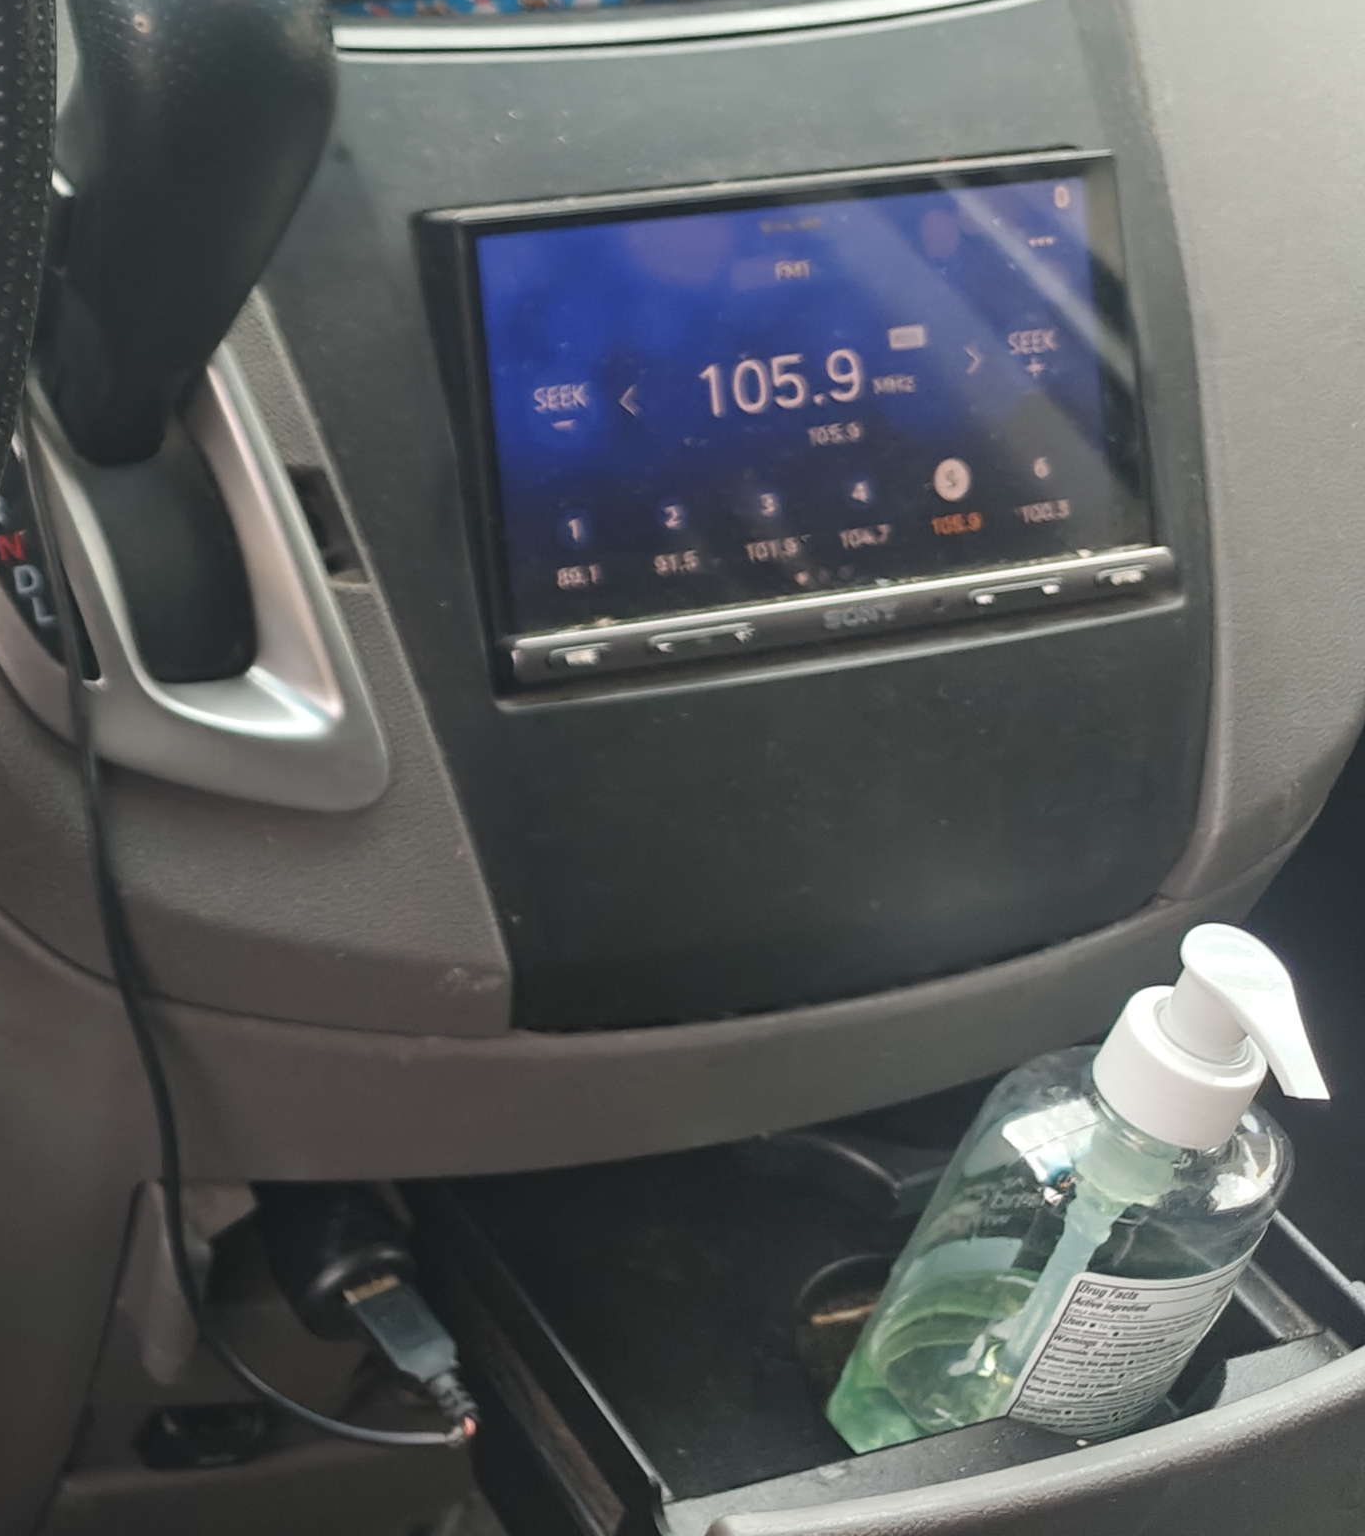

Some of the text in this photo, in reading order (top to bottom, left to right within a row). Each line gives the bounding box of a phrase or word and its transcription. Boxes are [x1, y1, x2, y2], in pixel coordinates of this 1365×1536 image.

[1008, 328, 1058, 356] SEEK
[698, 348, 864, 419] 105.9
[533, 384, 591, 412] SEEK
[1033, 456, 1050, 479] 6
[760, 493, 778, 516] 3
[851, 480, 870, 504] 4
[665, 505, 683, 529] 2
[567, 518, 583, 543] 1
[12, 564, 44, 595] D
[31, 596, 56, 626] L
[822, 601, 898, 629] SONY
[1078, 1283, 1140, 1301] Drug Facts
